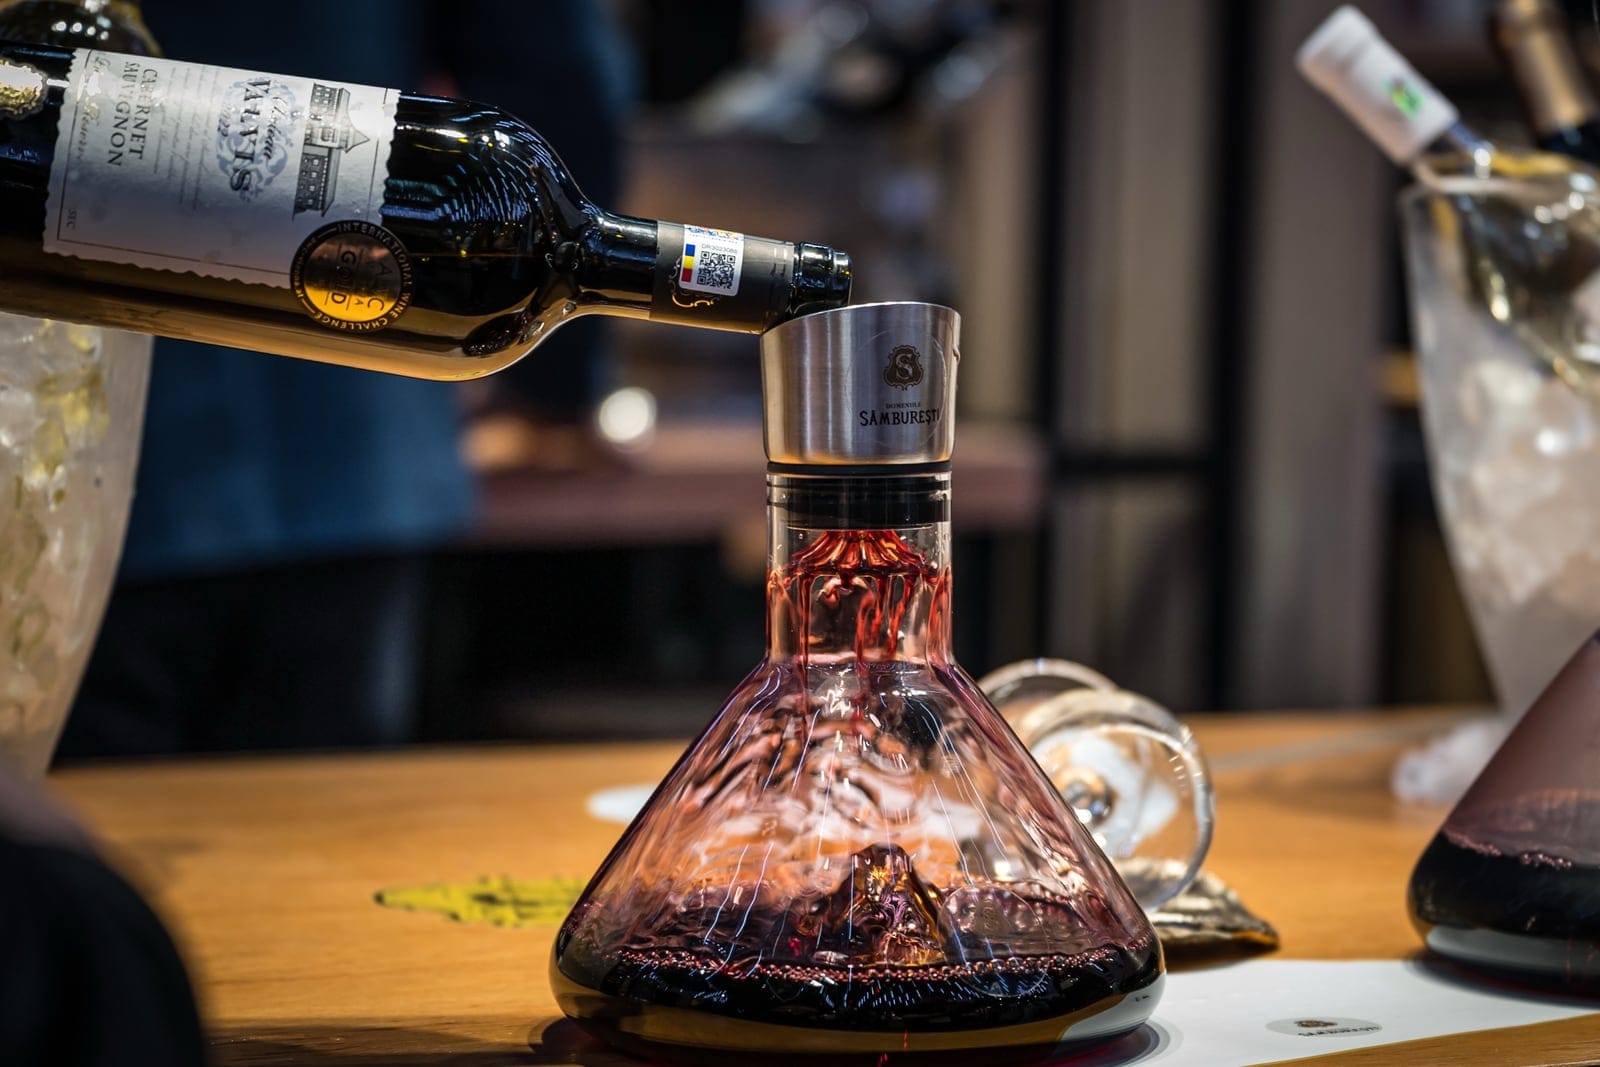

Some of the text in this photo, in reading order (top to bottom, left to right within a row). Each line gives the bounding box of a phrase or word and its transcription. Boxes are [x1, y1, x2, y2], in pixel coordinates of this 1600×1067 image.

[107, 61, 140, 167] SAUVIGNON
[129, 68, 158, 160] CABERNET
[230, 80, 271, 191] VALVIS
[264, 96, 287, 160] Chteau
[314, 222, 413, 330] INTERNATIONAL WINE CHALLENGE
